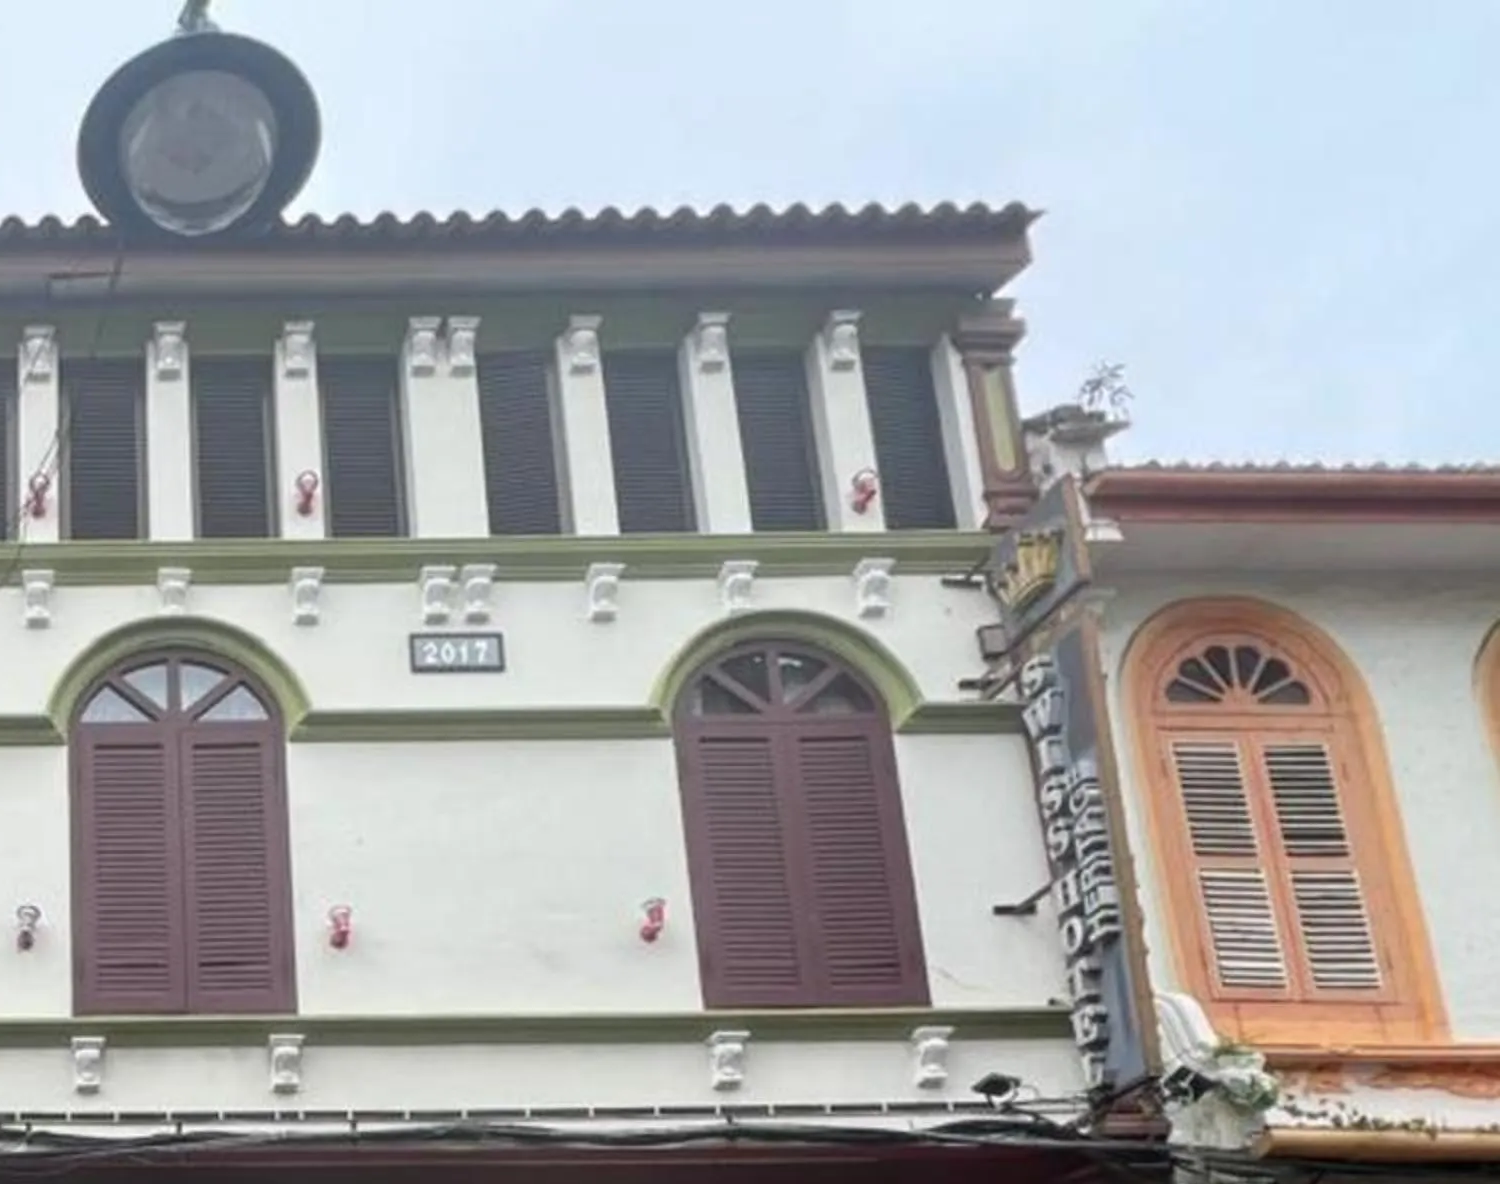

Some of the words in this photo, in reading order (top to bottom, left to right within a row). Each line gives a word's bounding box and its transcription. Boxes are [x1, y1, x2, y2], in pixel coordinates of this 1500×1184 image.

[422, 640, 489, 665] 2017
[1020, 654, 1072, 861] SWISS
[1056, 869, 1108, 1086] HOTEL
